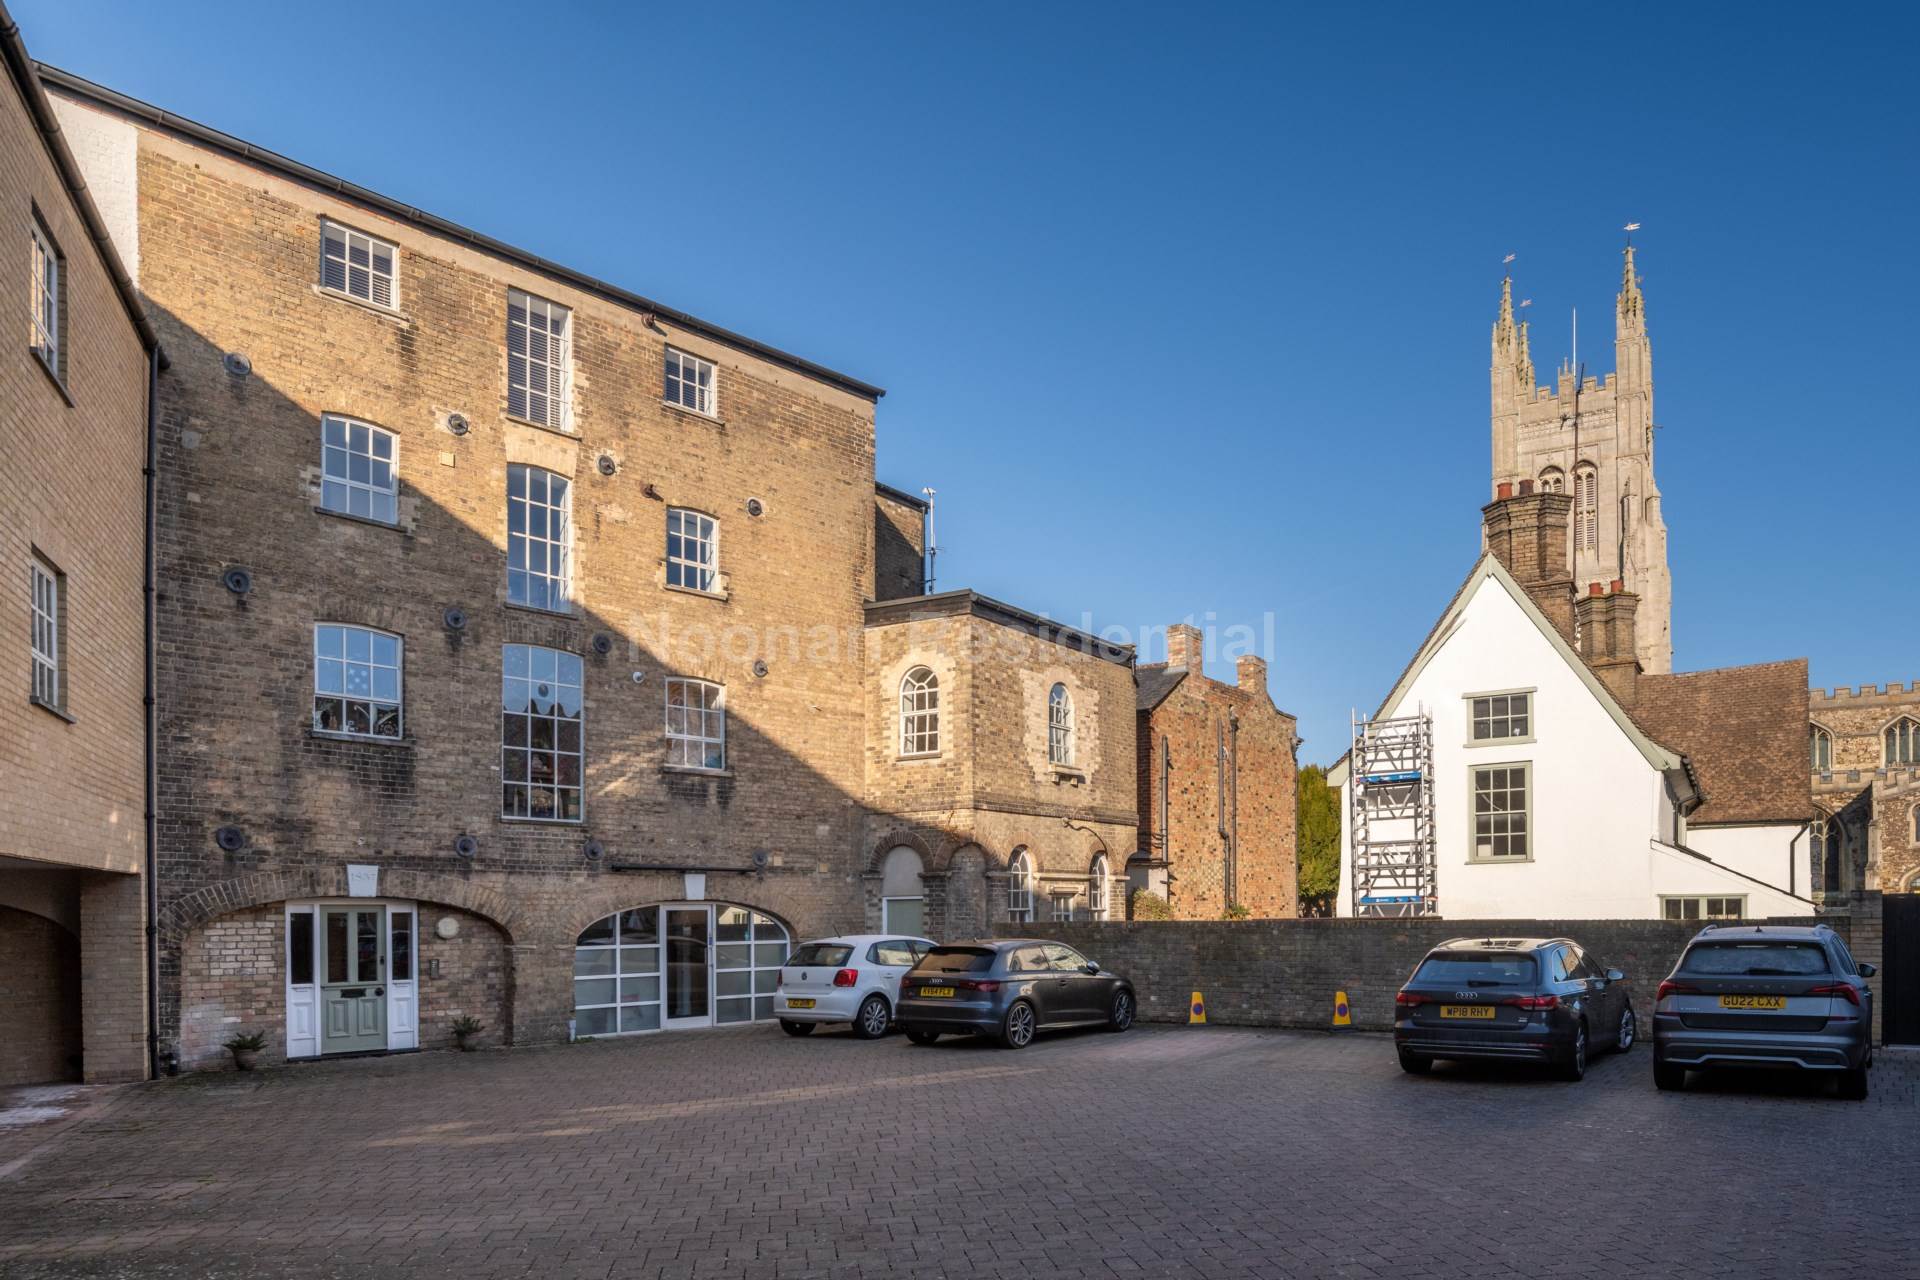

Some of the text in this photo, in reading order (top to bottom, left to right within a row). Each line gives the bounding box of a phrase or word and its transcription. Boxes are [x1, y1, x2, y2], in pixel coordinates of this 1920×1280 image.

[1757, 996, 1781, 1007] CXX
[1446, 1007, 1489, 1017] WP18 RHY
